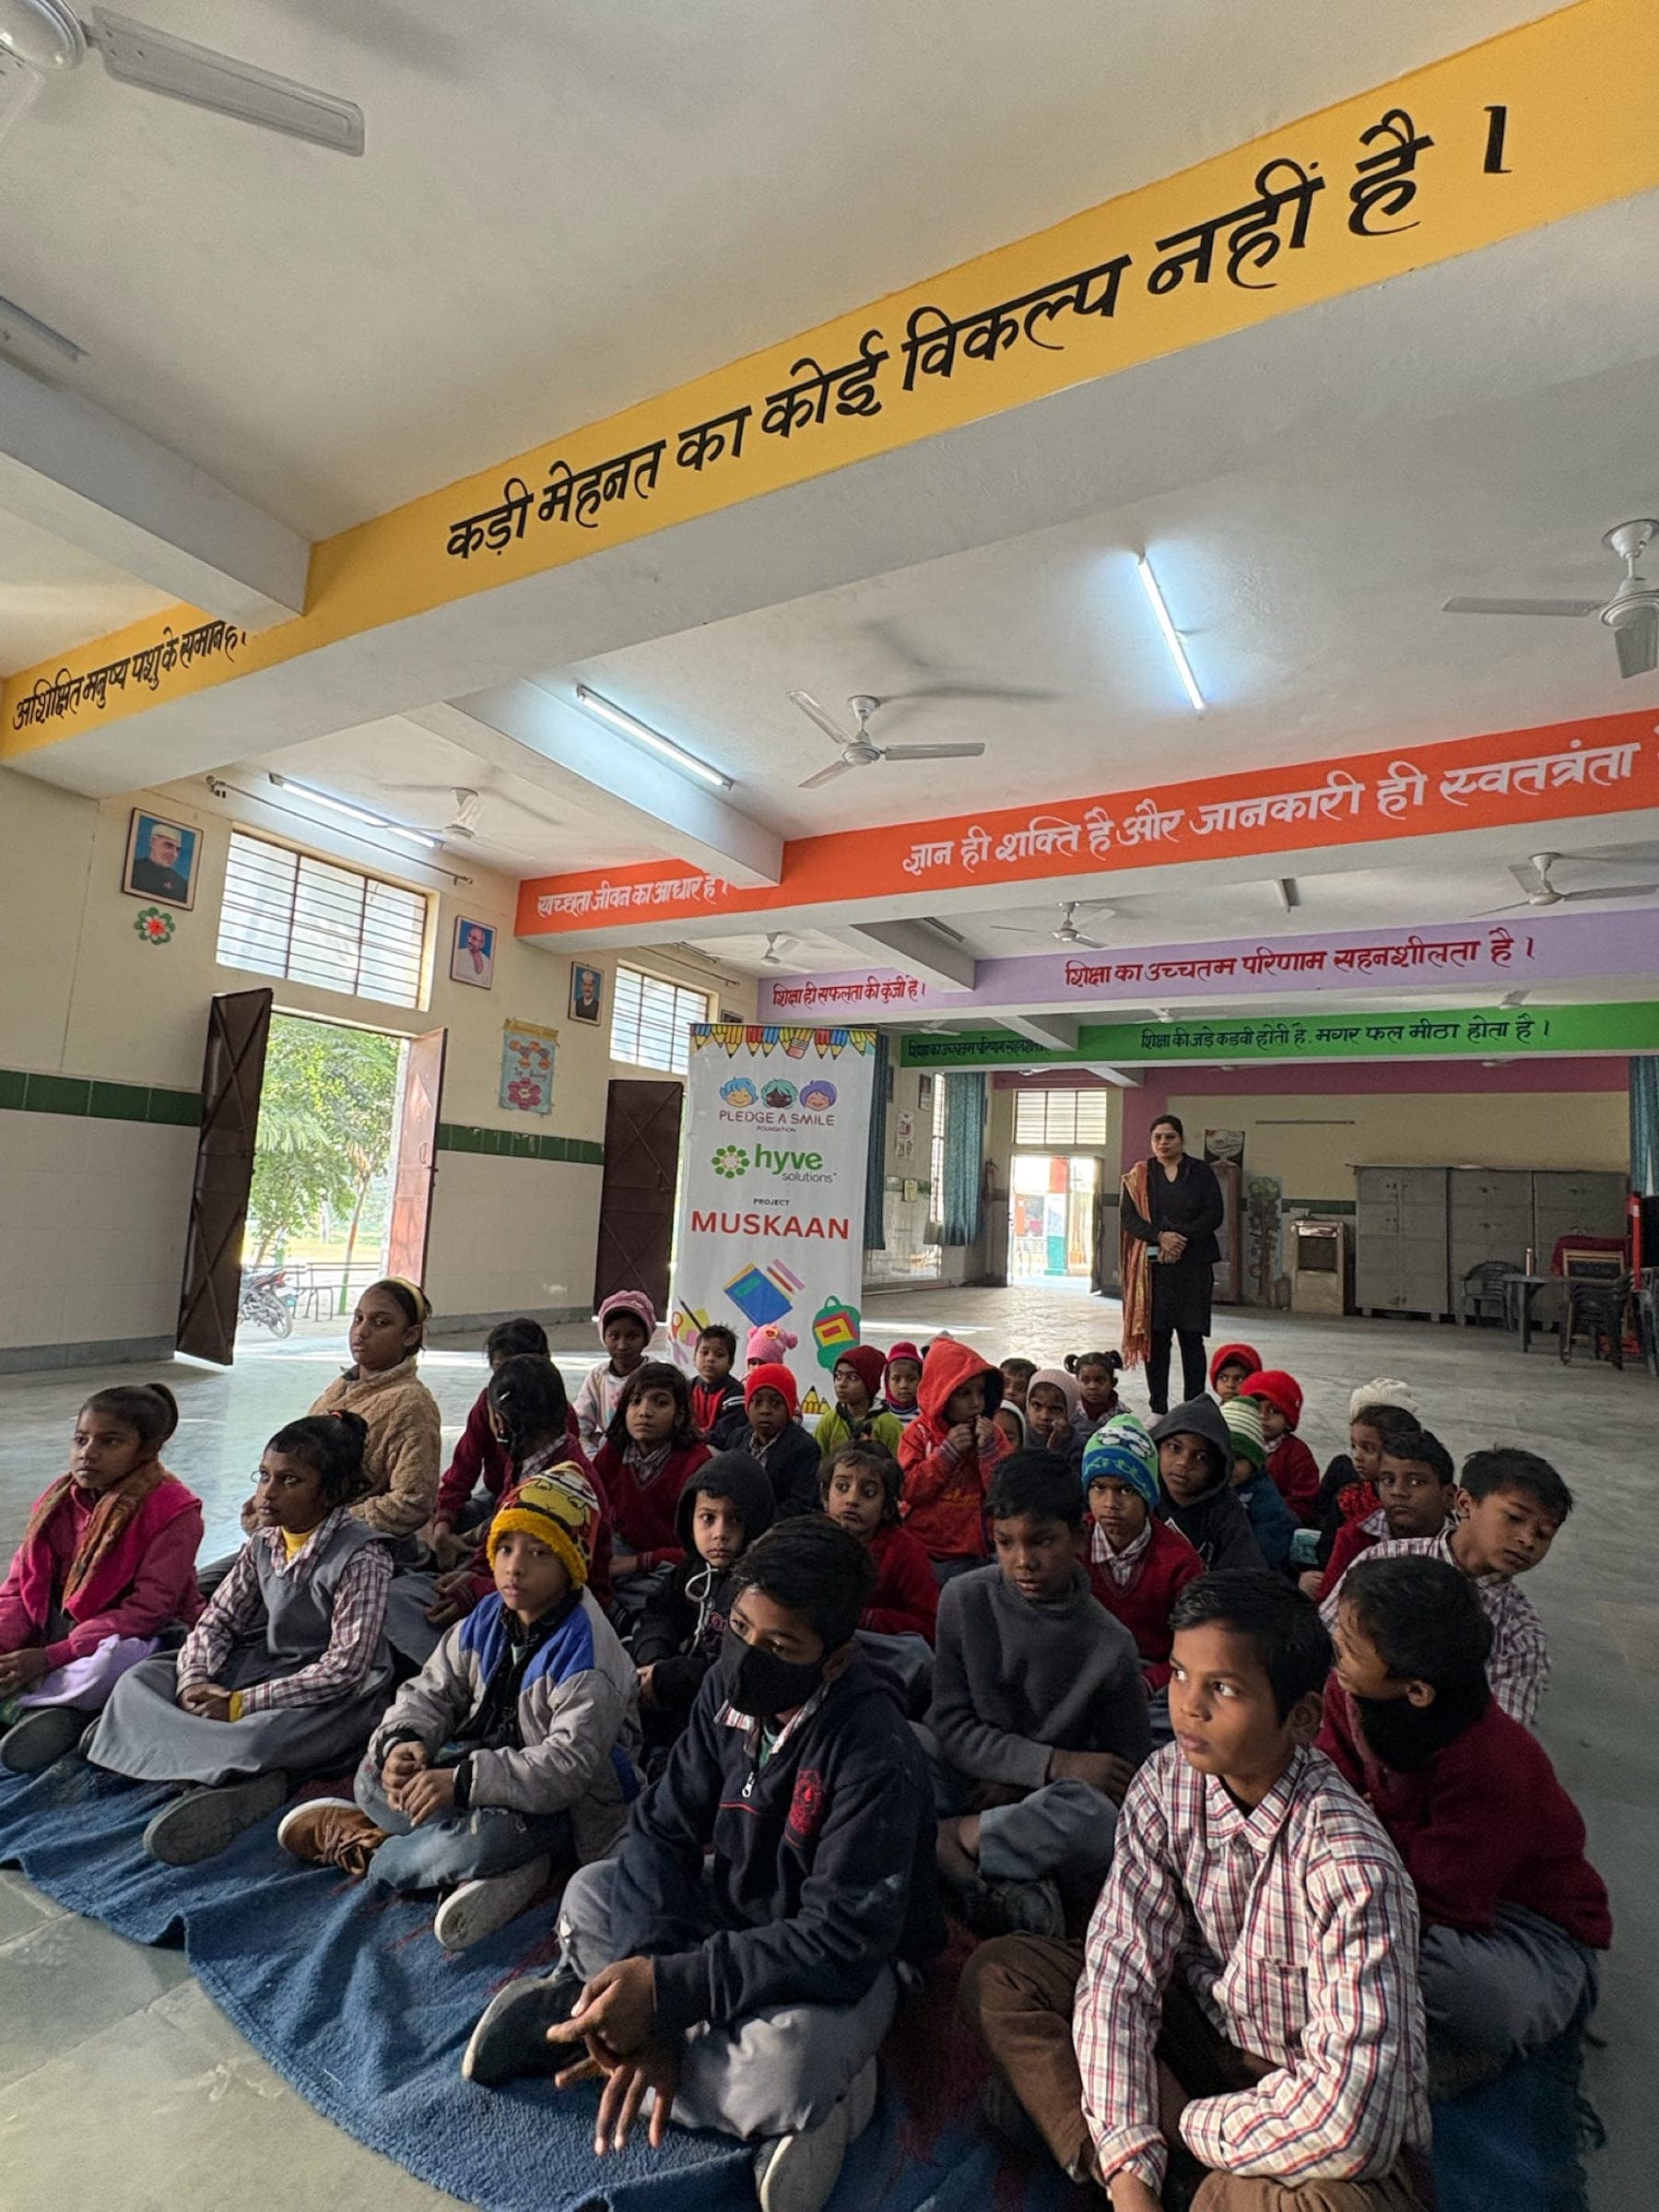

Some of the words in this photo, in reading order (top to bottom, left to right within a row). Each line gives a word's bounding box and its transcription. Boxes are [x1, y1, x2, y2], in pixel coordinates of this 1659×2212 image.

[447, 478, 534, 558] कड़ी
[538, 461, 666, 528] मेहनत
[677, 406, 752, 470] का
[761, 330, 889, 438] कोई
[900, 254, 1133, 391] विकल्प
[1147, 158, 1325, 295] नहीं
[1347, 108, 1435, 236] है
[13, 668, 85, 731] अशिक्षित
[82, 657, 131, 709] मनुष्य
[132, 643, 164, 691] पशु
[162, 626, 179, 672] के
[180, 619, 226, 668] समान
[902, 840, 955, 877] ज्ञान
[960, 825, 993, 874] ही
[994, 815, 1082, 862] शक्ति
[1084, 805, 1116, 862] है
[1116, 797, 1185, 847] और
[1189, 769, 1366, 835] जानकारी
[1377, 760, 1429, 820] ही
[591, 880, 632, 911] जीवन
[631, 882, 655, 906] का
[652, 875, 705, 904] आधार
[1065, 959, 1112, 987] शिक्षा
[1114, 963, 1144, 982] का
[1145, 959, 1238, 982] उच्चतम
[1241, 947, 1327, 975] परिणाम
[1333, 935, 1482, 974] सहनशीलता
[1488, 927, 1514, 969] है
[772, 983, 804, 1006] शिक्षा
[804, 981, 817, 1010] ही
[818, 985, 863, 1006] सफलता
[864, 975, 880, 1000] की
[1141, 1028, 1171, 1050] शिक्षा
[1171, 1026, 1189, 1047] की
[1256, 1023, 1289, 1051] होती
[1316, 1027, 1361, 1044] मगर
[1366, 1025, 1405, 1043] फल
[1467, 1015, 1510, 1043] होता
[1515, 1012, 1535, 1044] है
[719, 1110, 774, 1124] PLEDGE
[778, 1113, 786, 1124] A
[791, 1112, 835, 1126] SMILE
[754, 1143, 823, 1176] hyve
[753, 1198, 790, 1207] PROJECT
[690, 1210, 850, 1241] MUSKAAN
